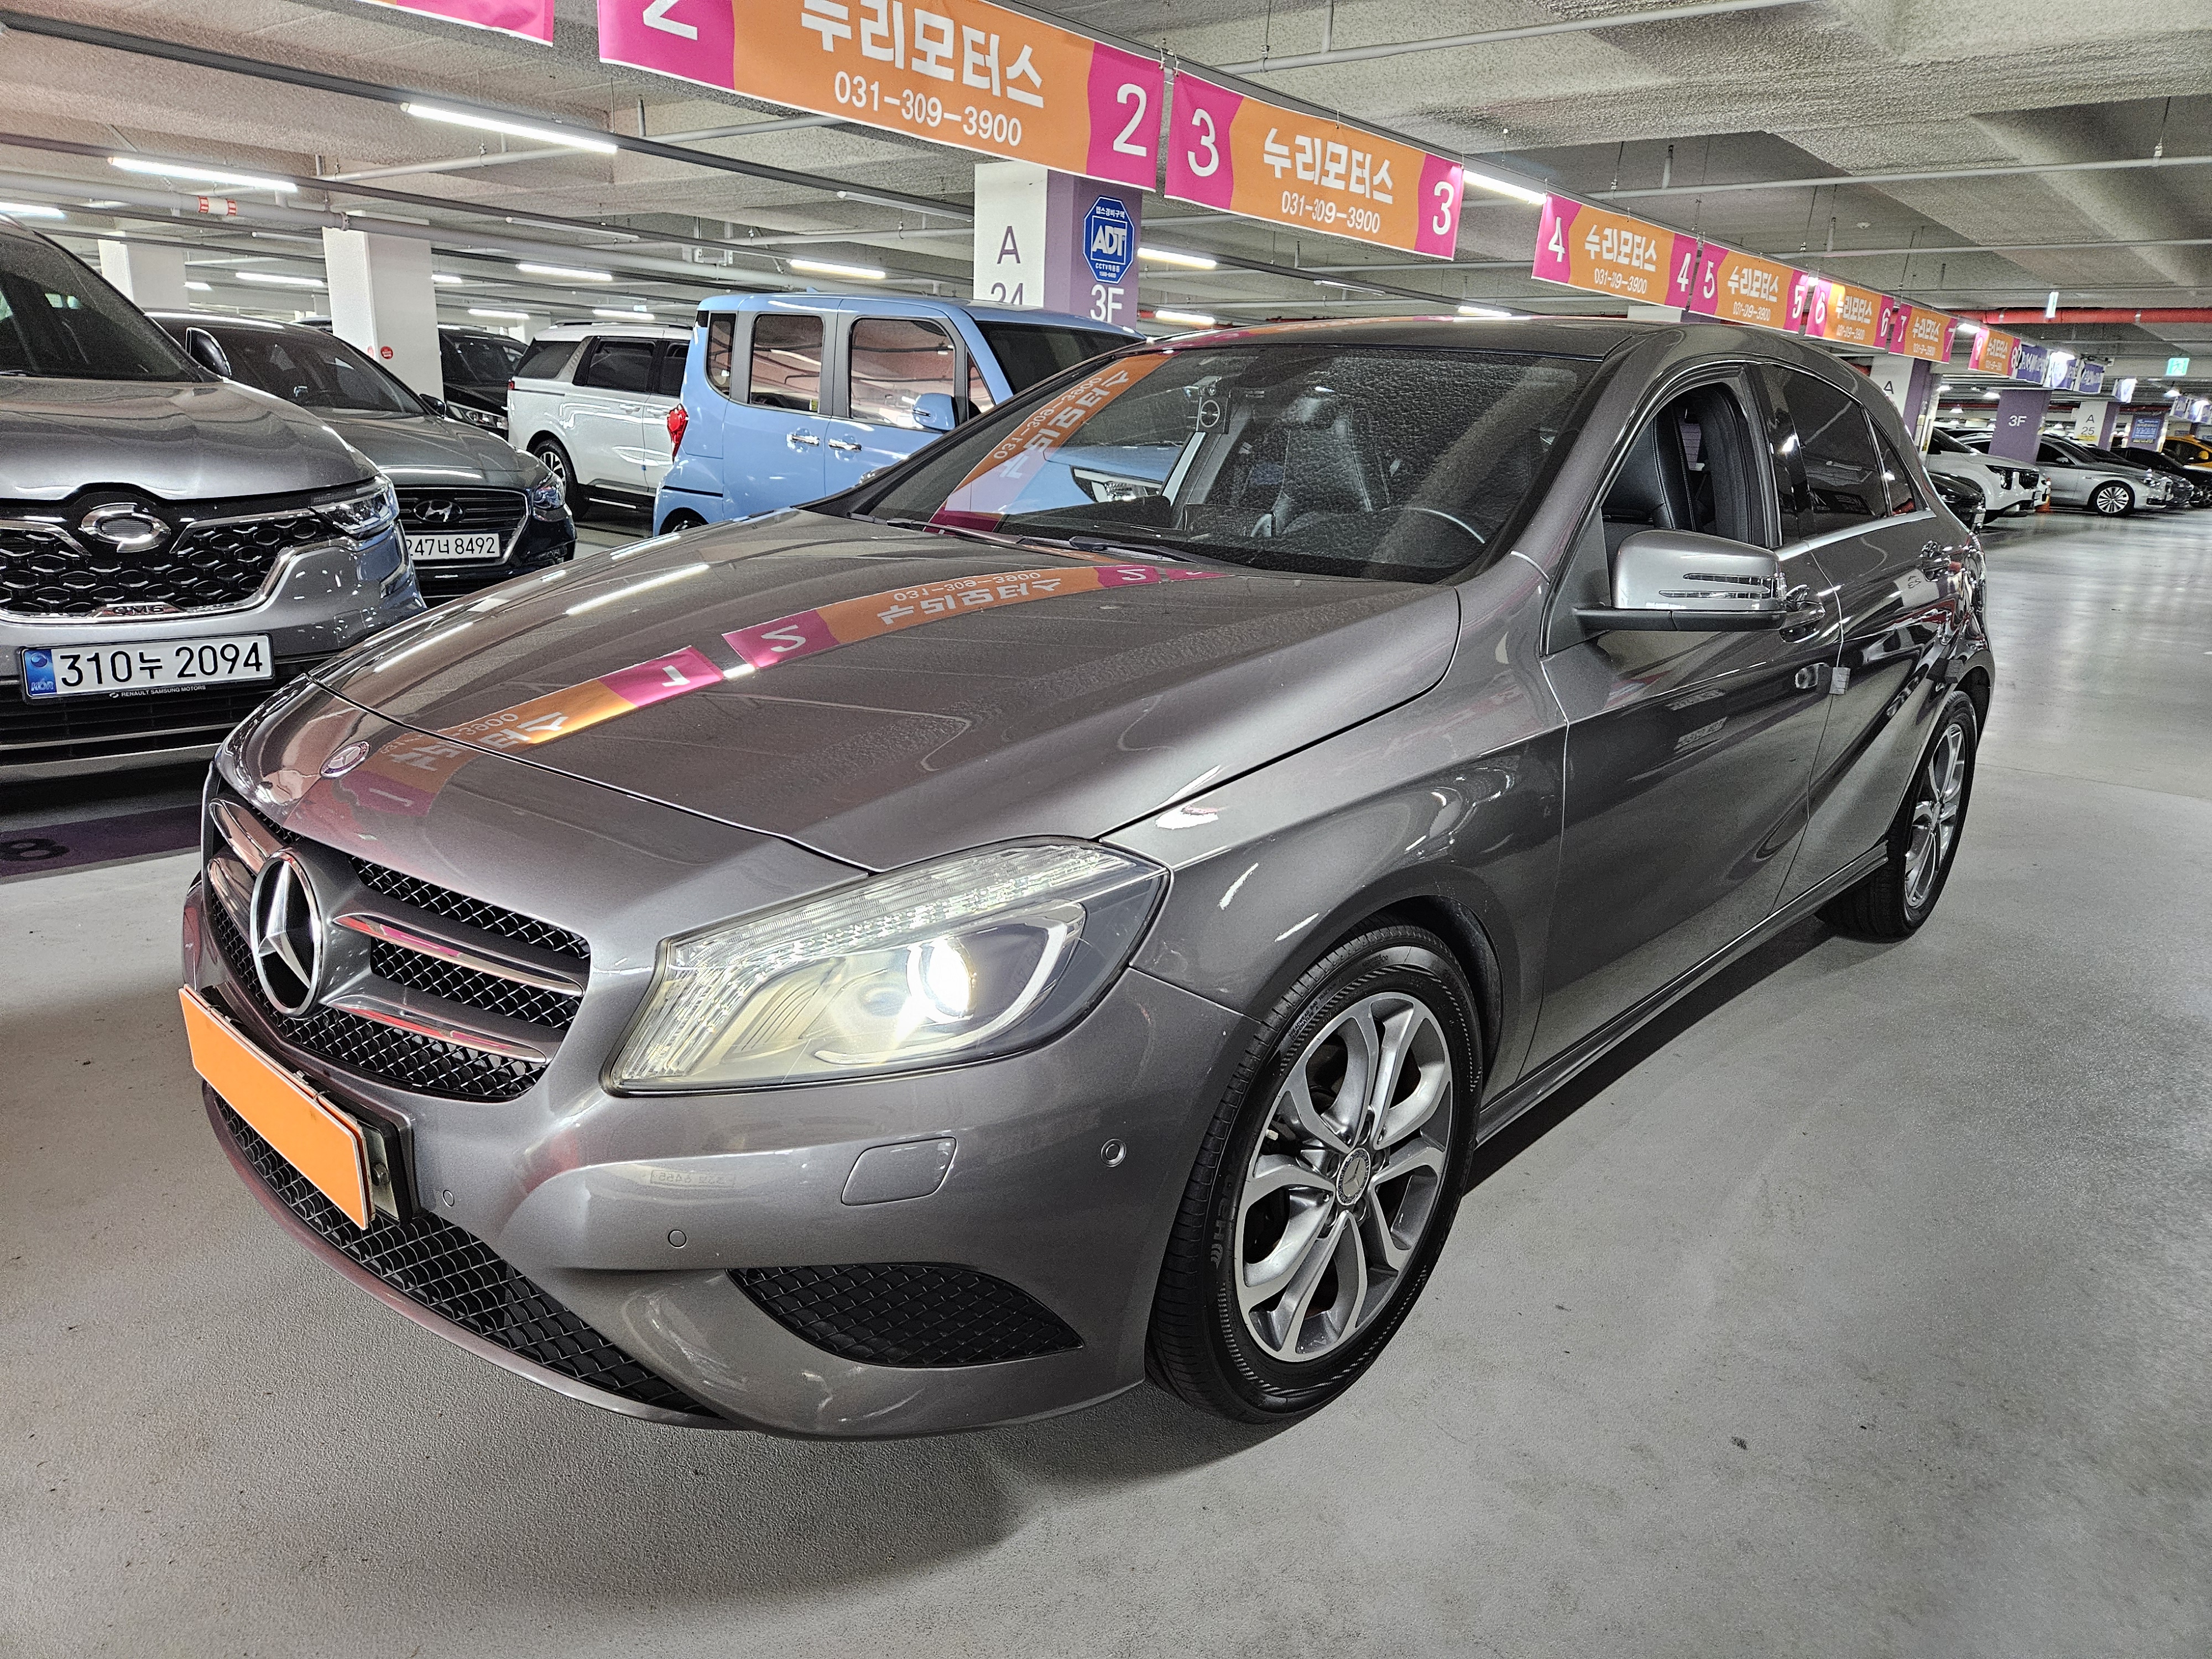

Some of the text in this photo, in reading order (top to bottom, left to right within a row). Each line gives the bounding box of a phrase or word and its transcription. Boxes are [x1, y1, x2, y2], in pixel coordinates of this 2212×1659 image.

[835, 71, 1022, 146] 031-309-3900
[1112, 83, 1147, 156] 2
[1187, 108, 1219, 176] 3
[1264, 128, 1393, 205] 누리모터스
[1281, 190, 1380, 234] 031-309-3900
[1432, 181, 1454, 236] 3
[997, 226, 1020, 264] A
[1092, 225, 1126, 256] ADT
[1548, 216, 1565, 263] 4
[1585, 224, 1657, 272] 누리모터스
[1677, 253, 1691, 292] 4
[1703, 260, 1715, 299] 5
[1727, 266, 1778, 302] 누리모터스
[1090, 284, 1124, 323] 3F
[1792, 284, 1806, 319] 5
[1815, 291, 1825, 324] 6
[1835, 293, 1872, 324] 누리모터스
[1880, 307, 1891, 337] 6
[1898, 316, 1907, 342] 7
[1884, 380, 1894, 394] A
[2008, 415, 2027, 427] 3F
[2081, 427, 2095, 435] 25
[2086, 415, 2095, 423] A
[455, 536, 495, 555] 8492
[59, 641, 263, 688] 310누 2094
[30, 677, 54, 692] KOR
